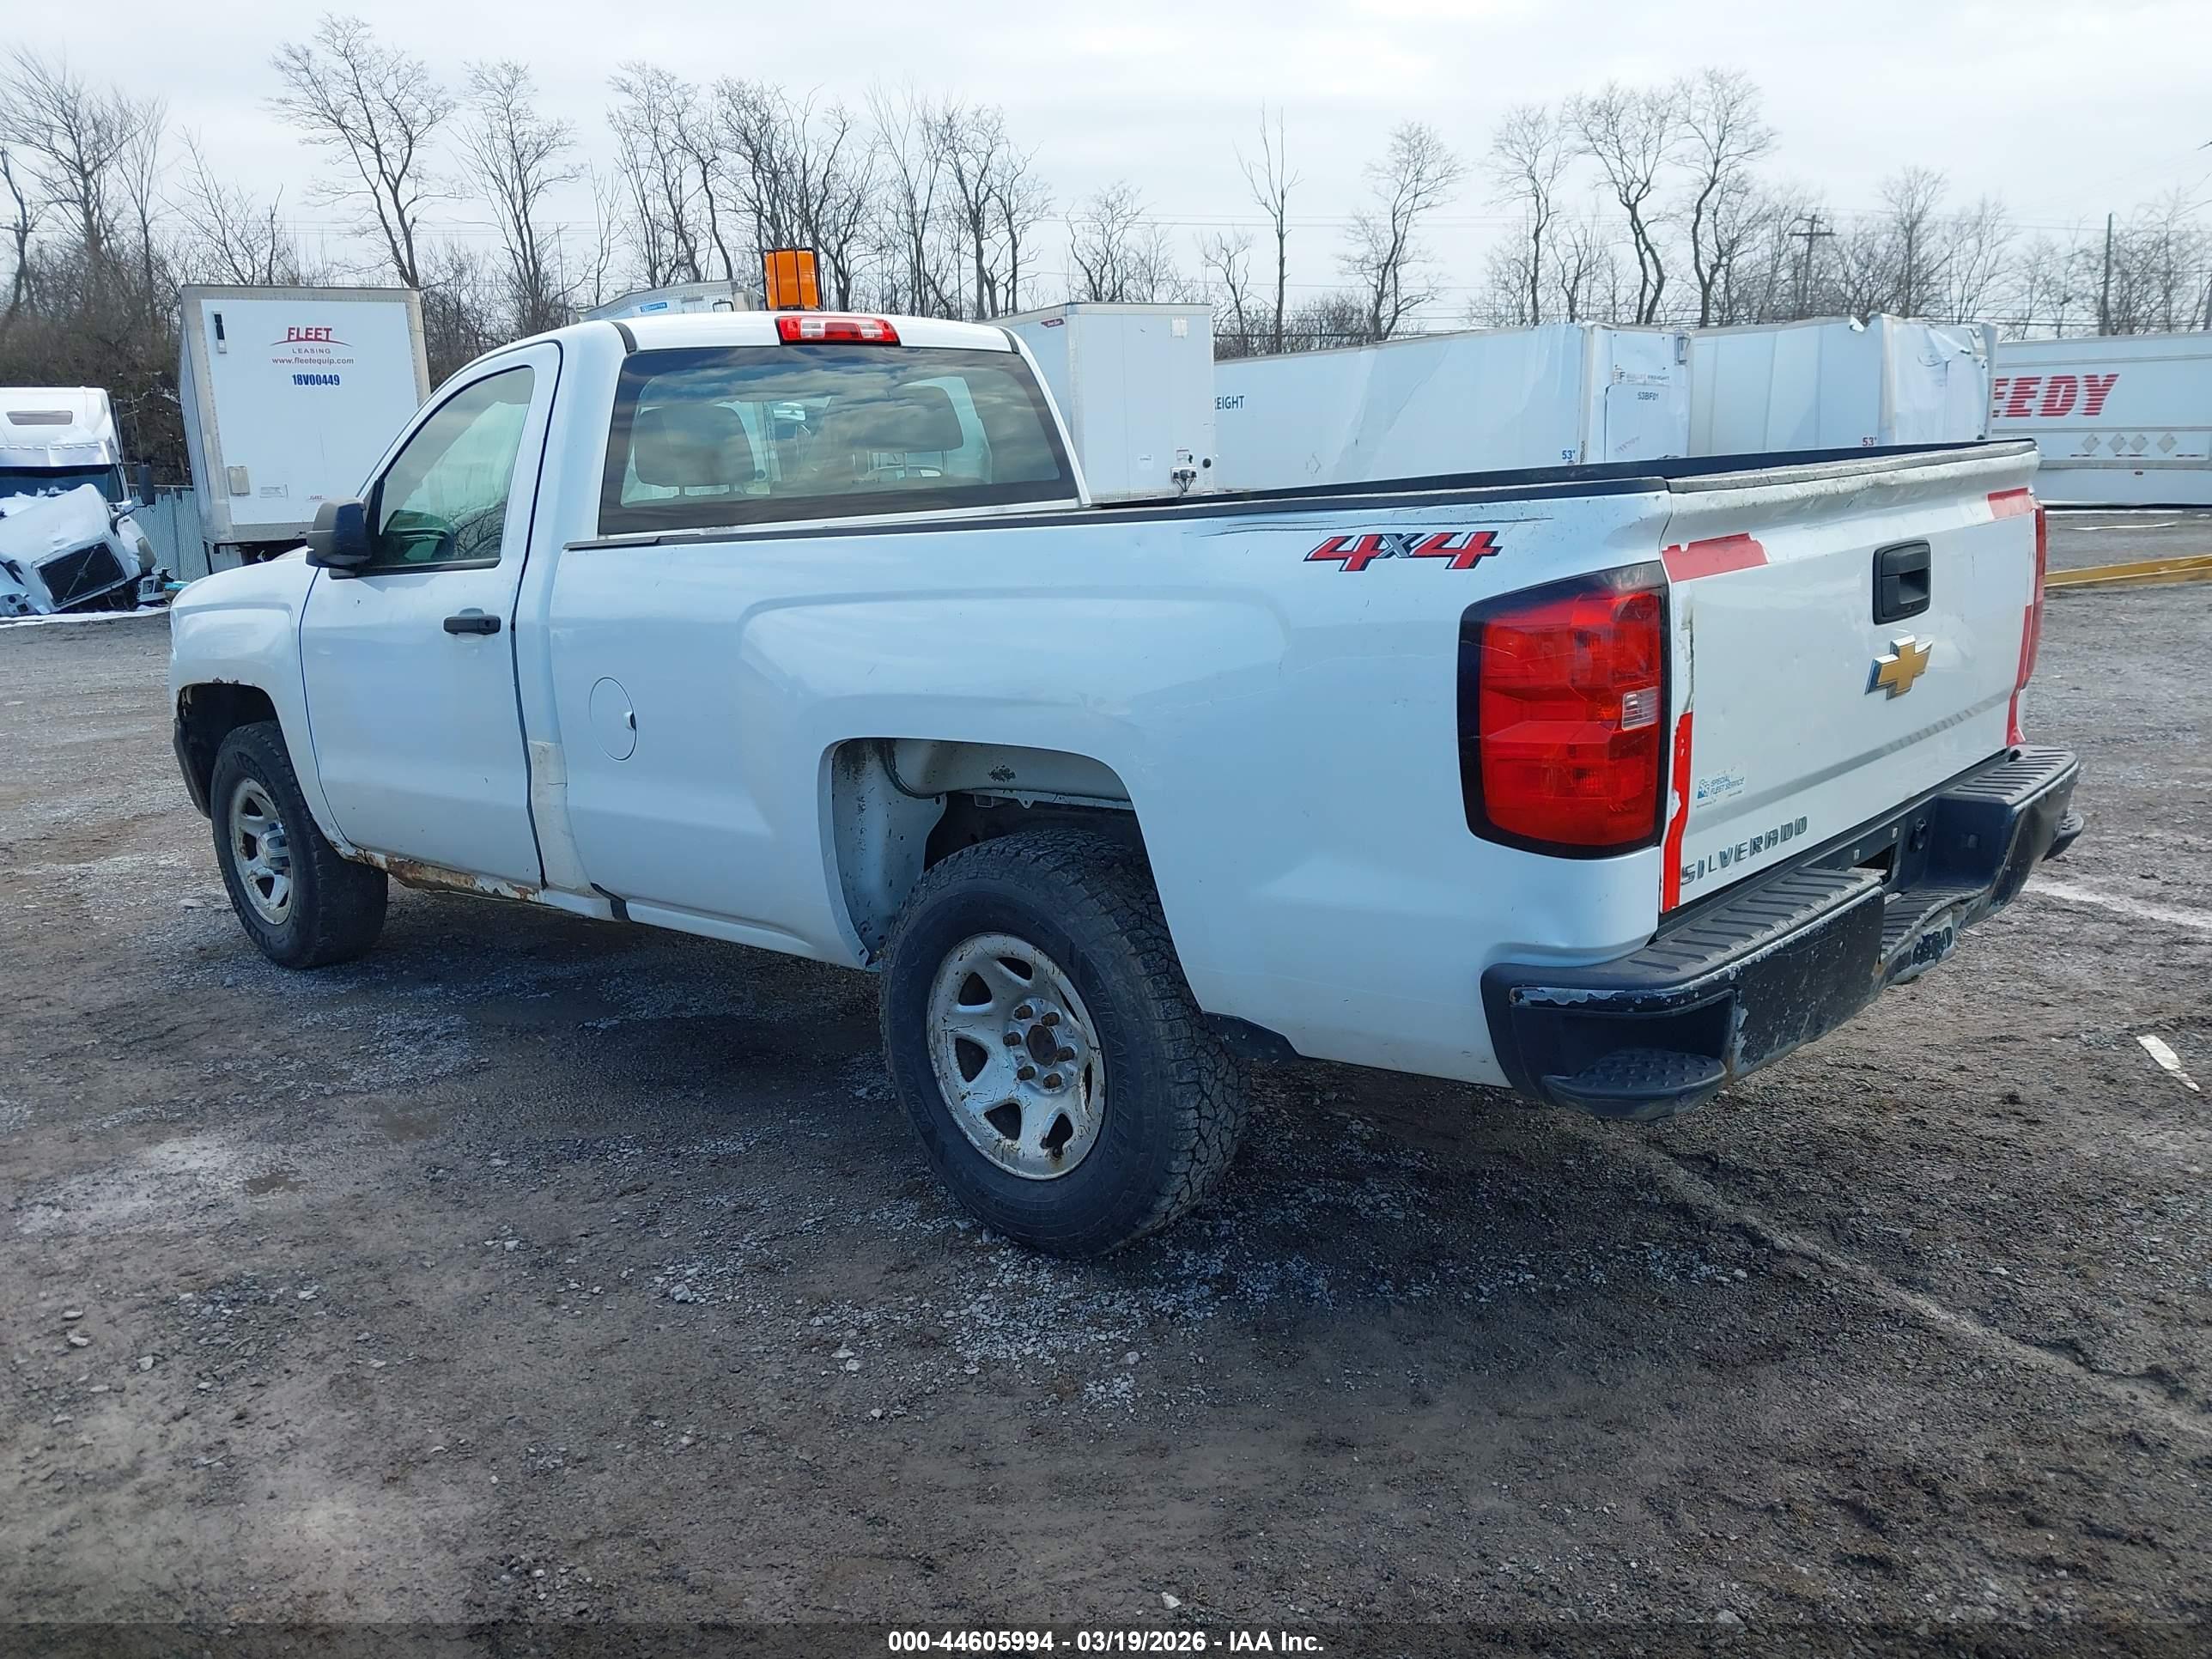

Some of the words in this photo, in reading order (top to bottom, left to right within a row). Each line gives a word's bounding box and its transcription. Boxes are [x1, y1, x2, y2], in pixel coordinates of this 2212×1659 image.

[288, 327, 332, 341] FLEET
[272, 357, 354, 366] www.fleetequip.com
[292, 374, 340, 386] 18V00449
[1215, 395, 1245, 410] EIGHT
[1863, 436, 1877, 447] 53'
[1562, 449, 1576, 460] 53'
[1680, 816, 1808, 886] SILVERADO
